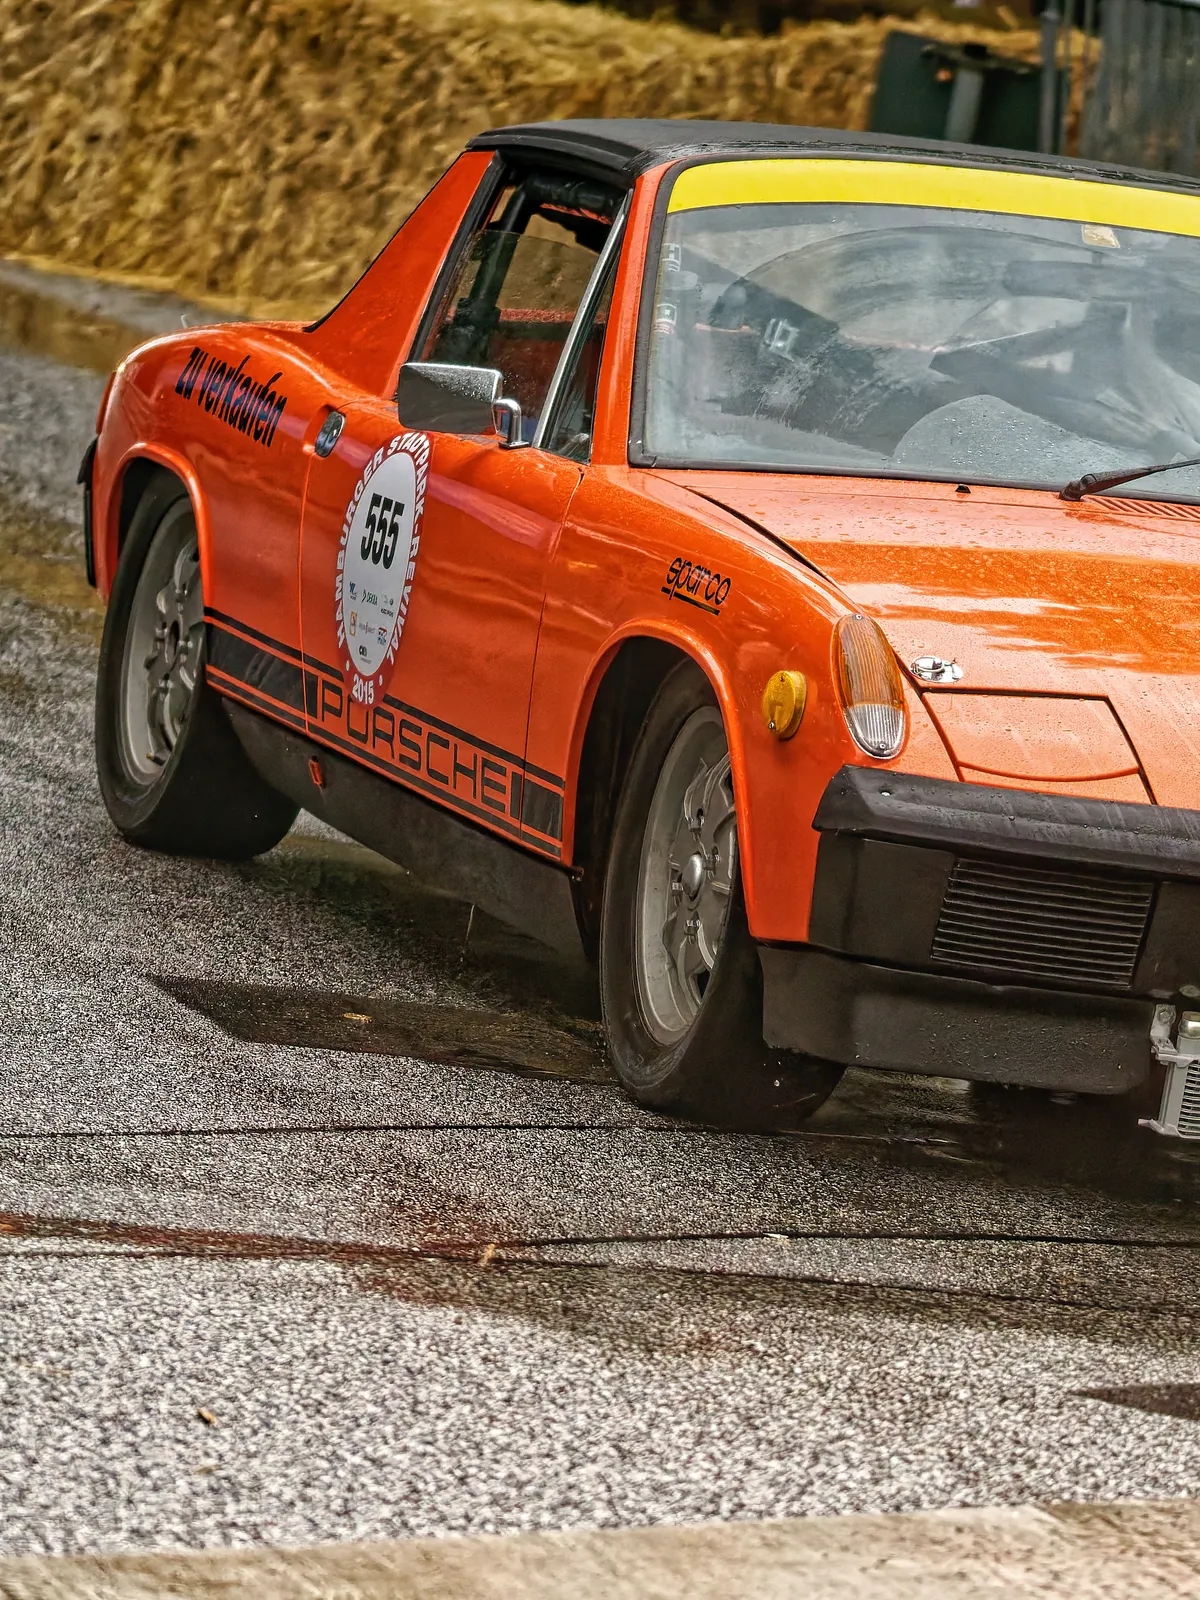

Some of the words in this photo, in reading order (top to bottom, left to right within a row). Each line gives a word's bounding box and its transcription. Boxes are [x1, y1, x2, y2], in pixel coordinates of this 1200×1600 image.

[175, 346, 208, 400] zu
[197, 354, 288, 447] verkaufen
[335, 446, 385, 649] HAMBURGER
[361, 492, 406, 570] 555
[665, 557, 731, 606] sparco
[351, 673, 375, 705] 2015
